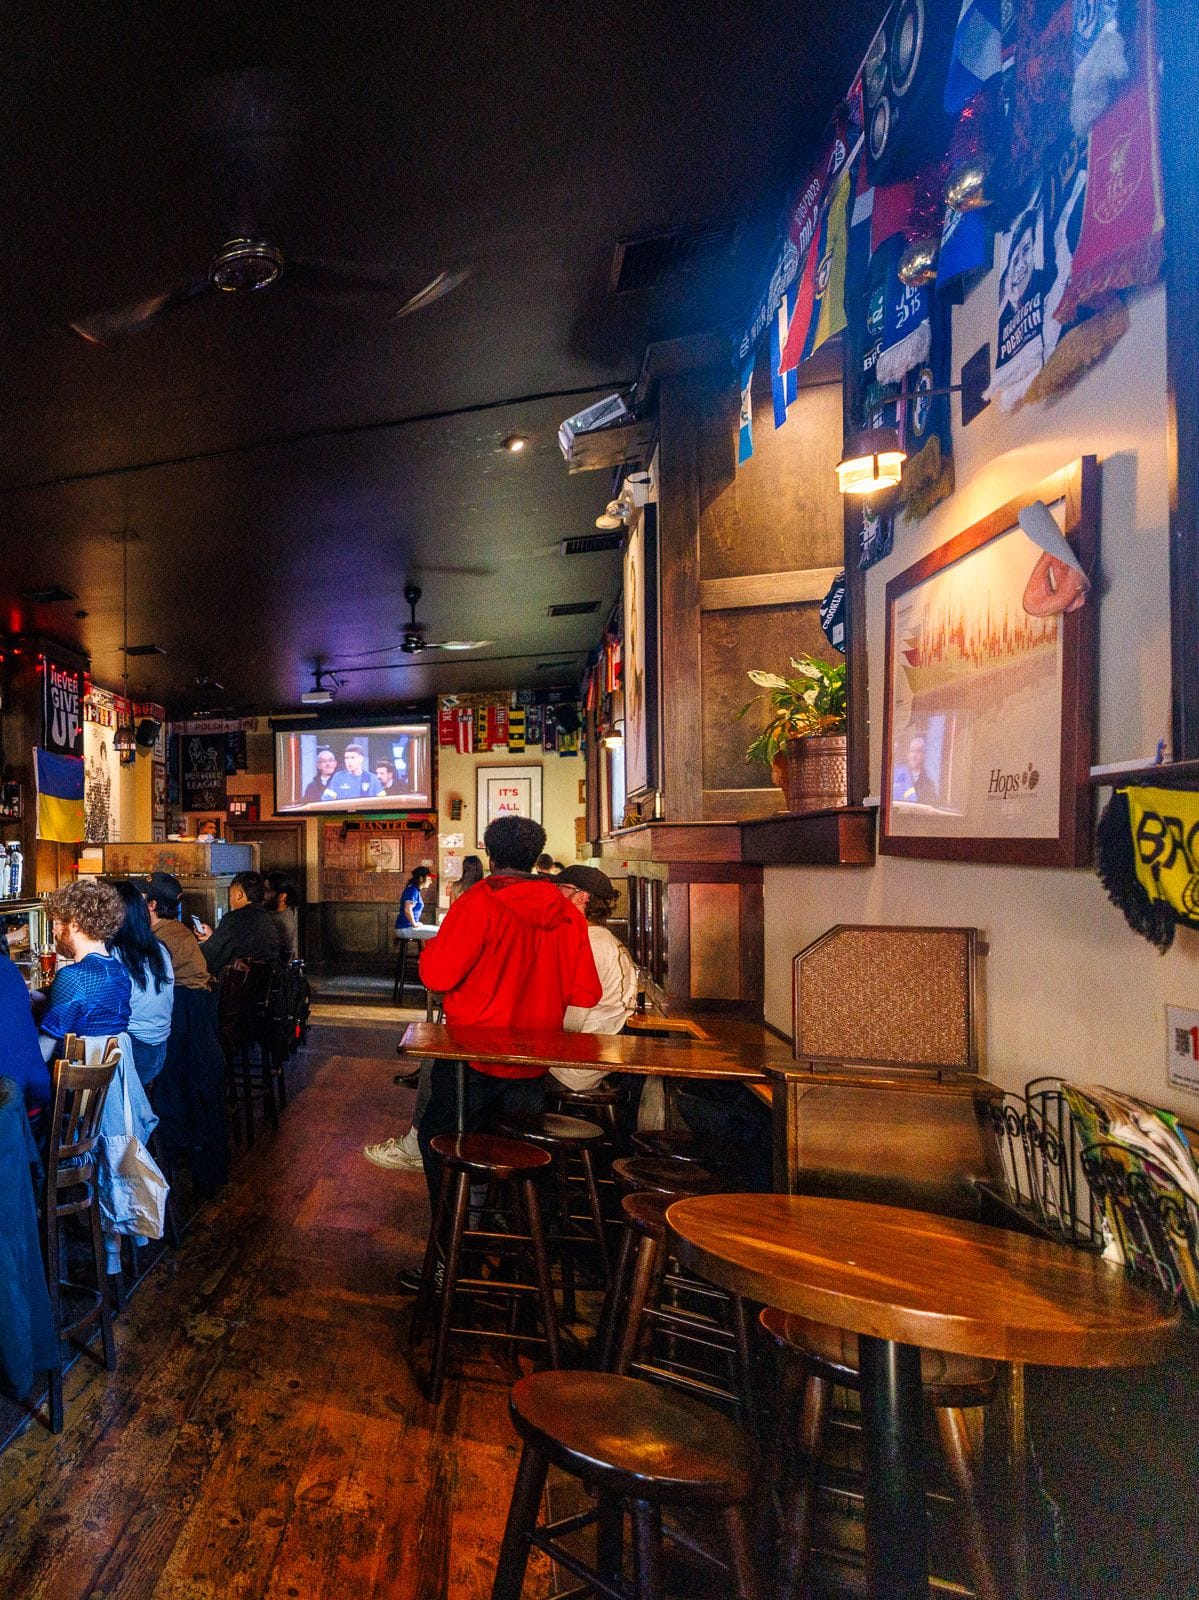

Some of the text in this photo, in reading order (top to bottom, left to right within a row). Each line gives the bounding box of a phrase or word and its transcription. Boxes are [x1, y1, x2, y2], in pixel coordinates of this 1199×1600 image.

[51, 671, 78, 693] NEVER
[51, 686, 79, 714] GIVE
[52, 708, 79, 749] UP
[196, 722, 231, 731] POLSKA
[187, 780, 221, 789] LEAGUE
[988, 769, 1020, 799] Hops
[499, 788, 519, 796] IT'S
[498, 803, 519, 811] ALL
[360, 822, 408, 830] BANTER
